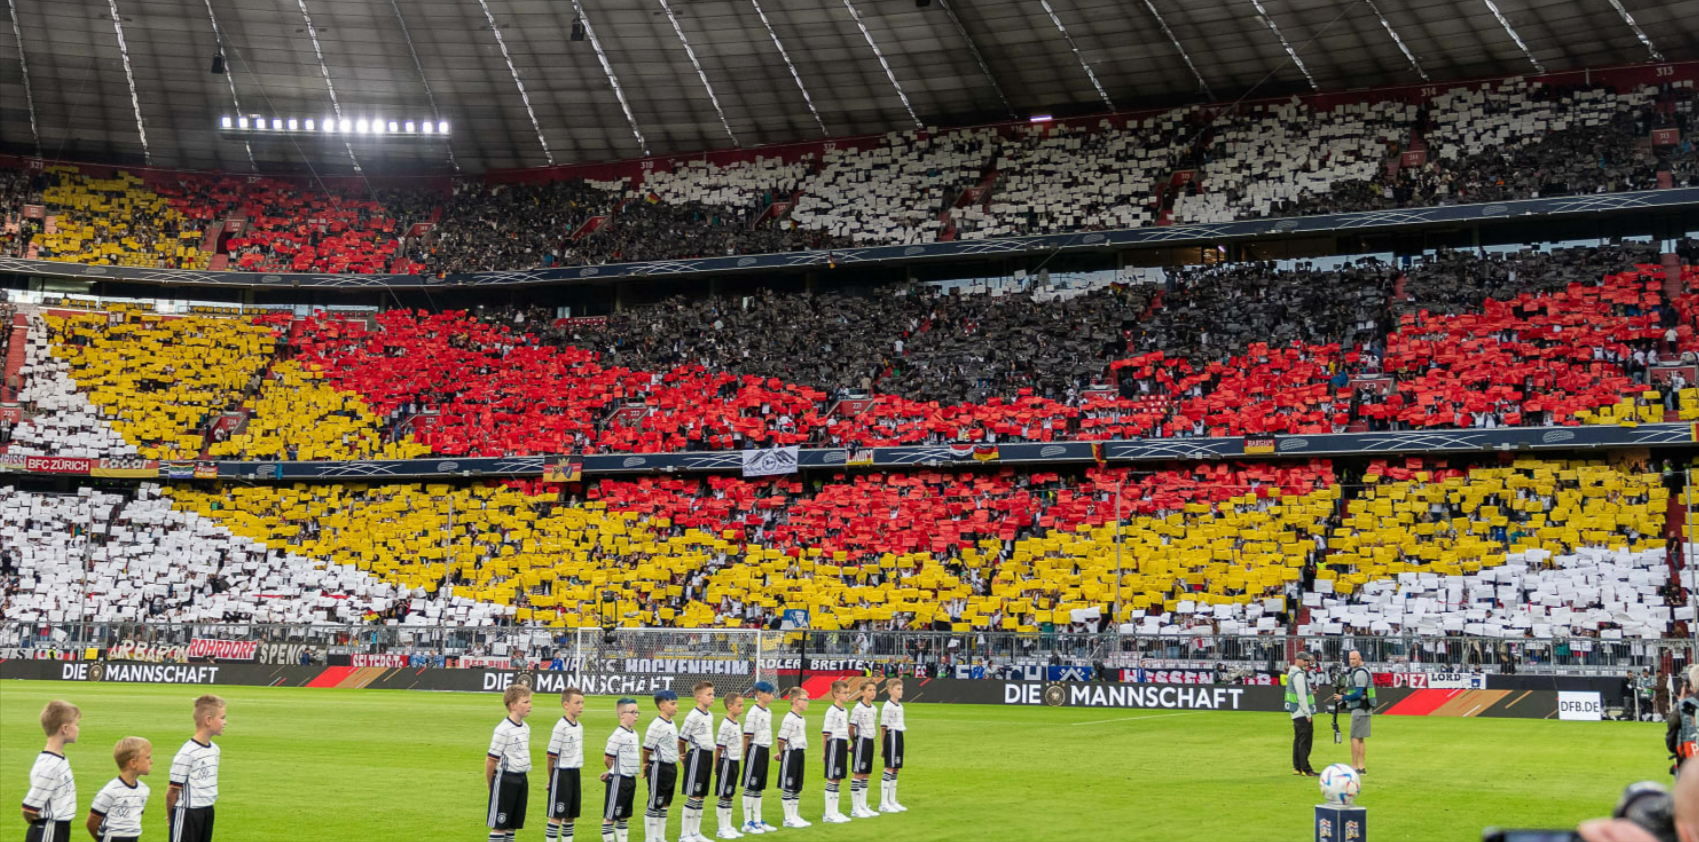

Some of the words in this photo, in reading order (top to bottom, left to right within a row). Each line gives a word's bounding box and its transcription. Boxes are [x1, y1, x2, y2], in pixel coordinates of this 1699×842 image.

[28, 458, 49, 470] BFC
[50, 458, 89, 471] ZÜRICH
[188, 638, 257, 659] ROHRDORF
[62, 663, 88, 680] DIE
[105, 664, 219, 684] MANNSCHAFT
[625, 659, 748, 674] HOCKENHEIM
[483, 672, 514, 690] DIE
[536, 673, 675, 694] MANNSCHAFT
[1393, 673, 1427, 688] DIEZ
[1431, 673, 1461, 681] LORD
[1004, 683, 1042, 704] DIE
[1071, 685, 1244, 710] MANNSCHAFT
[1560, 701, 1600, 713] DFB.DE
